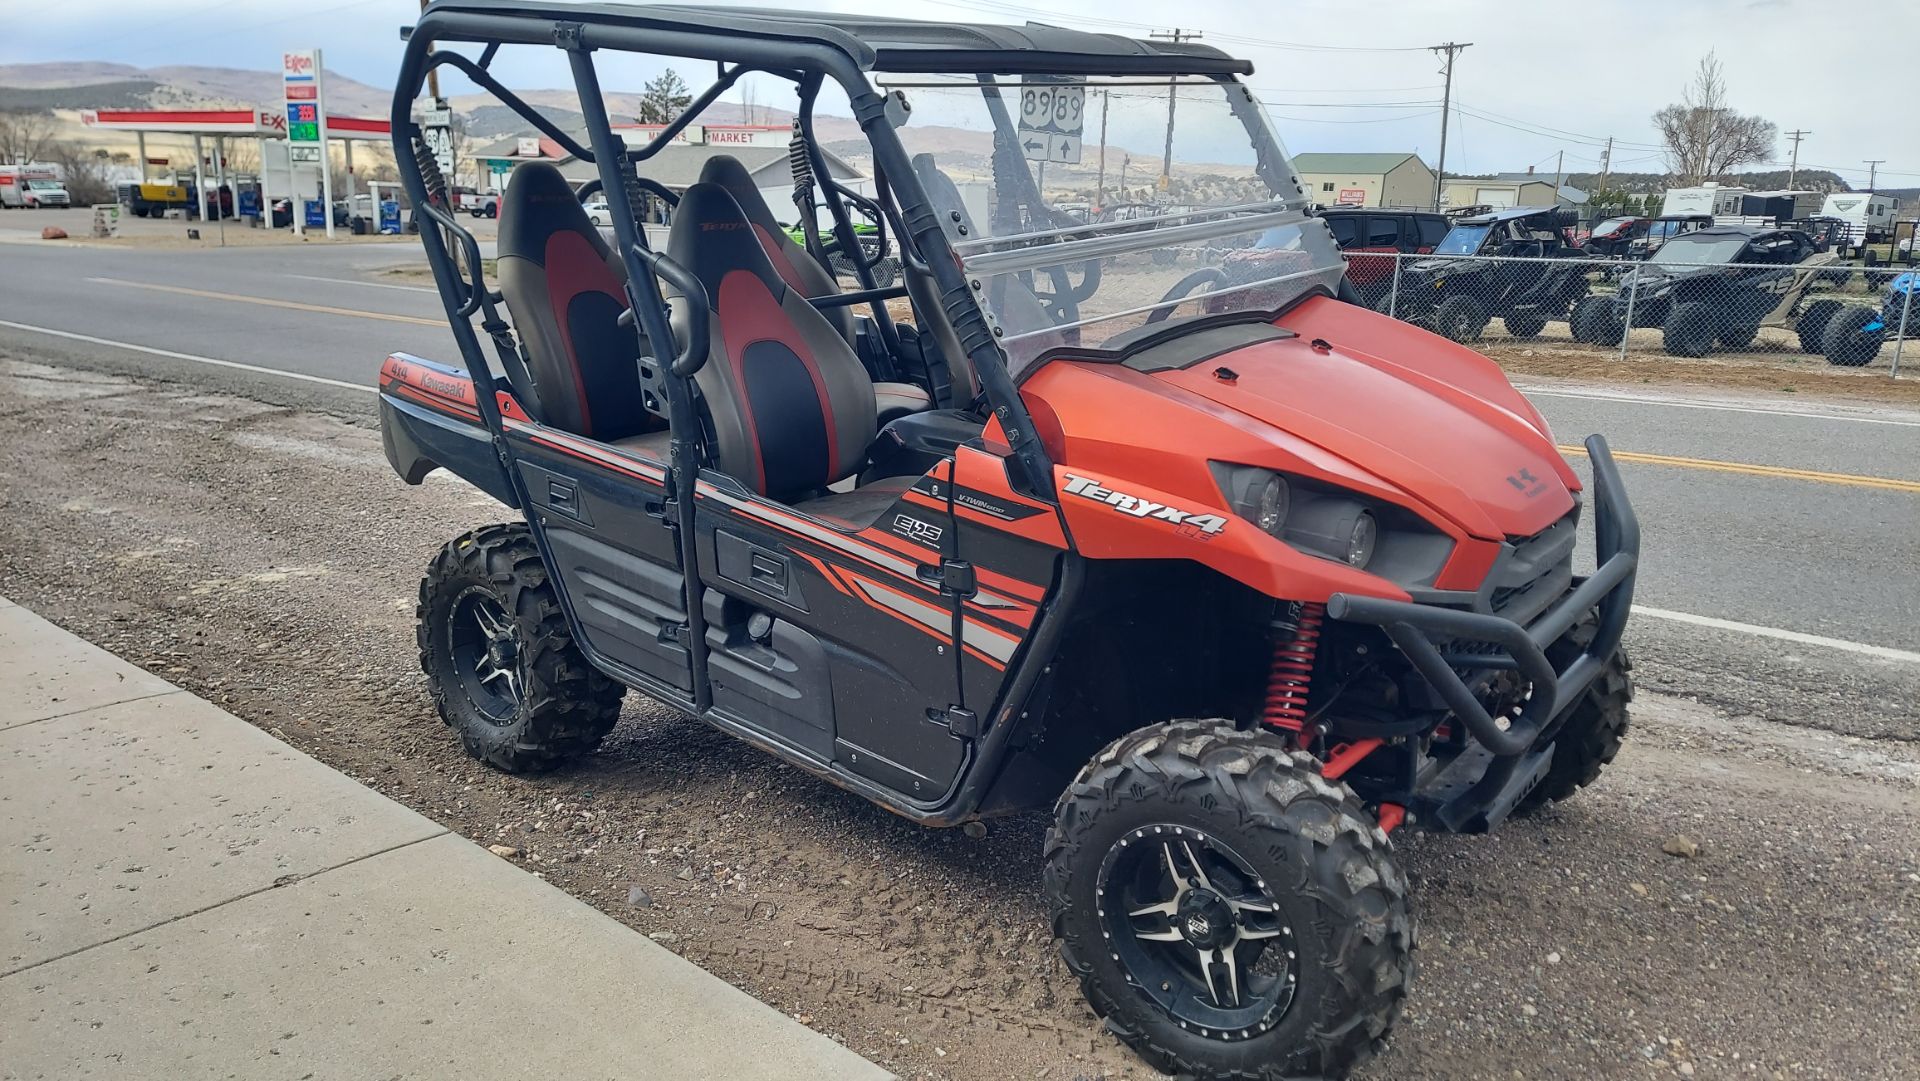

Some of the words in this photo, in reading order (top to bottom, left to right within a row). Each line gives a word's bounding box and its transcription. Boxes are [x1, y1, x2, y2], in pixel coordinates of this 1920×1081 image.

[1024, 89, 1050, 116] 89
[1056, 95, 1080, 121] 89
[712, 133, 754, 143] MARKET
[391, 363, 408, 380] 4x4
[420, 371, 466, 399] Kawasaki
